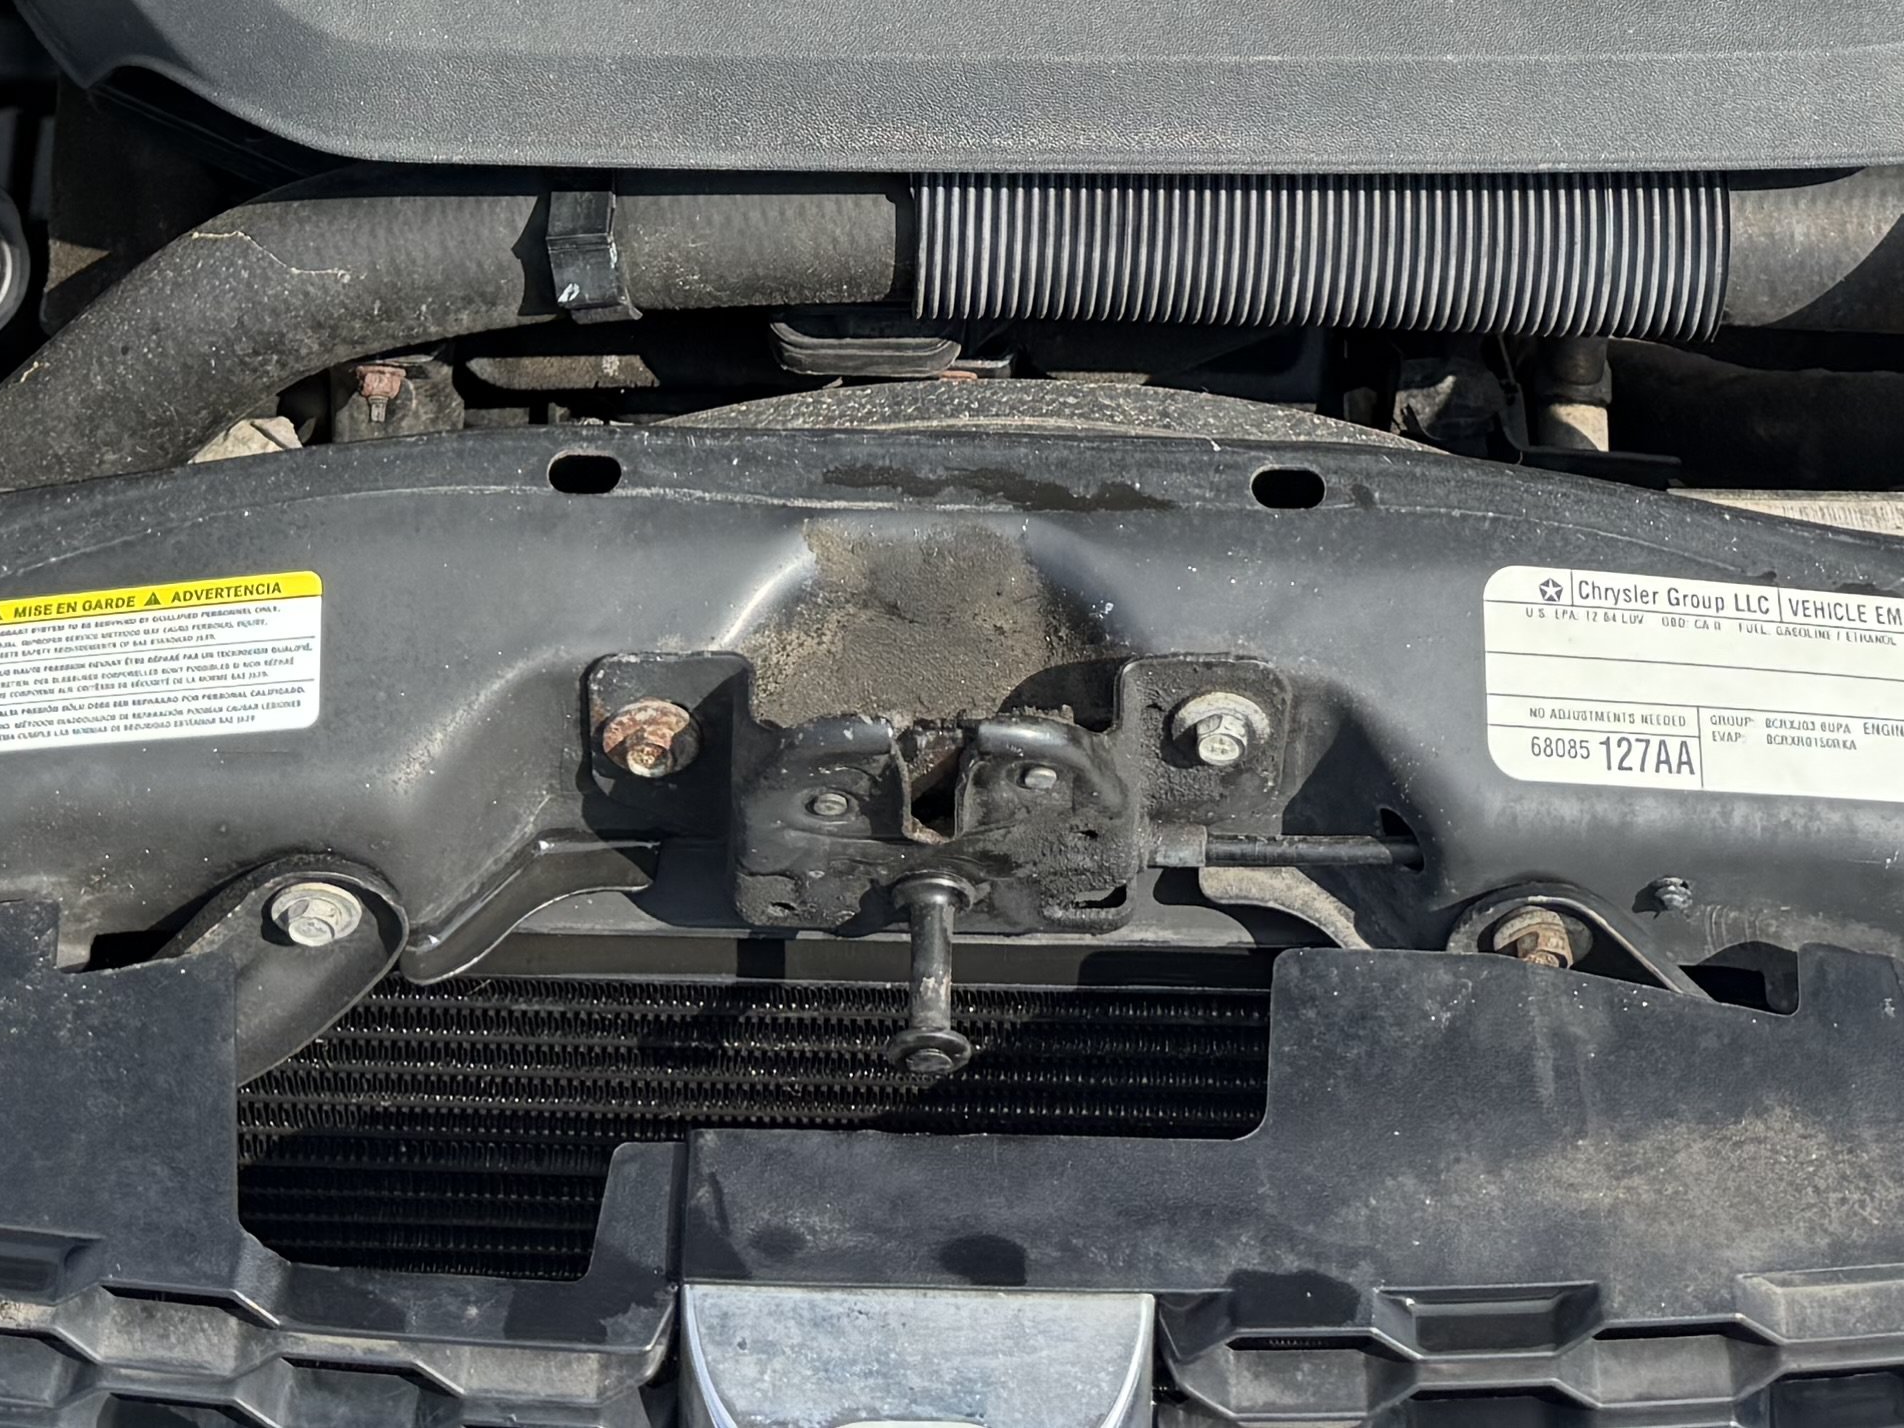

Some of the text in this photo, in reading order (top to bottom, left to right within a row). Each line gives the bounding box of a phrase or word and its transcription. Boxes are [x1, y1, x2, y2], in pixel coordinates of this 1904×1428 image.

[170, 582, 282, 604] ADVERTENCIA
[1578, 580, 1770, 615] Chrysler Group LLC
[13, 596, 136, 619] MISE EN GARDE
[1788, 597, 1867, 623] VEHICLE
[1529, 707, 1687, 727] NO ADJUSTMENTS NEEDED
[1531, 735, 1696, 776] 68085 127AA
